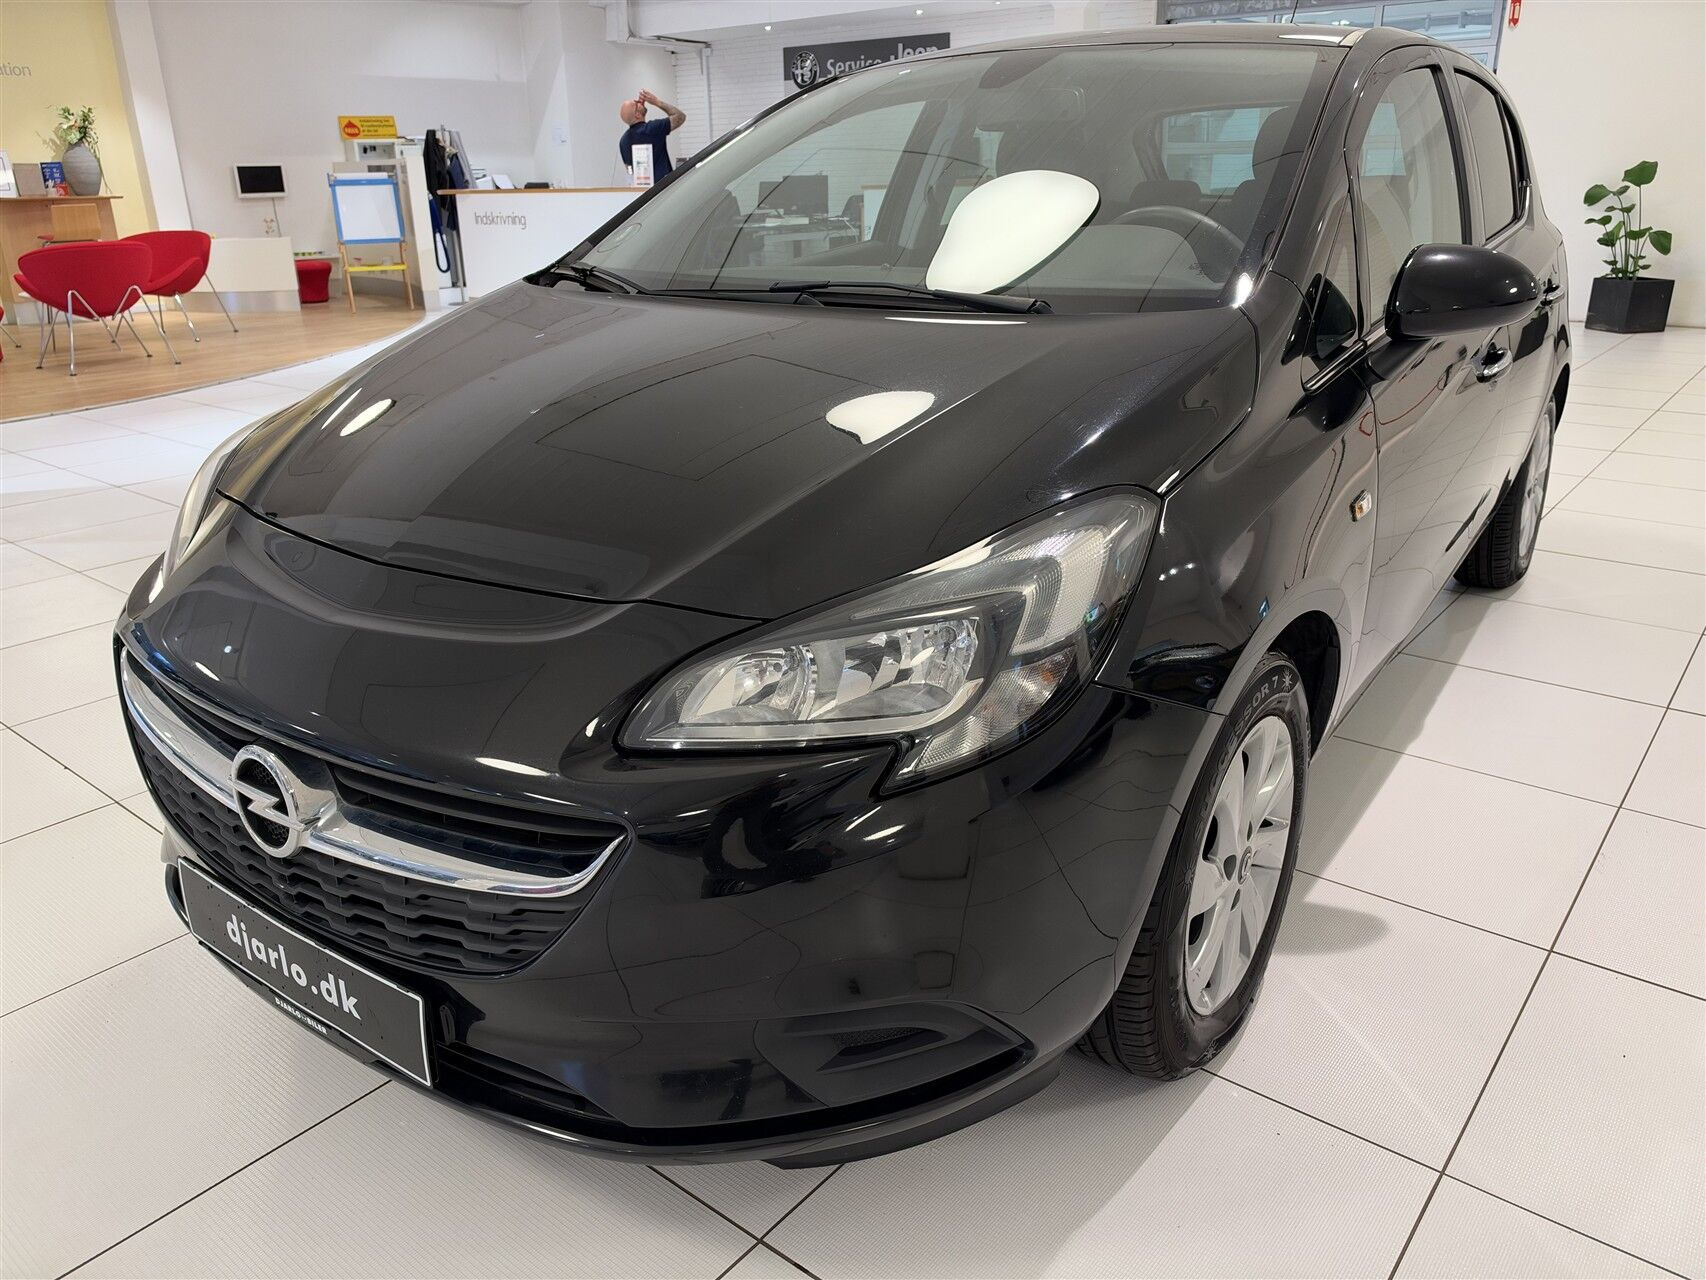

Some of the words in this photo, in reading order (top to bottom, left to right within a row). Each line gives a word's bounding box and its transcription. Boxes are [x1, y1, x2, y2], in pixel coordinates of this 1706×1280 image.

[890, 43, 938, 60] Je
[474, 211, 527, 230] Indskrivning
[1271, 675, 1279, 690] 7
[226, 914, 362, 1020] djarlo.dk
